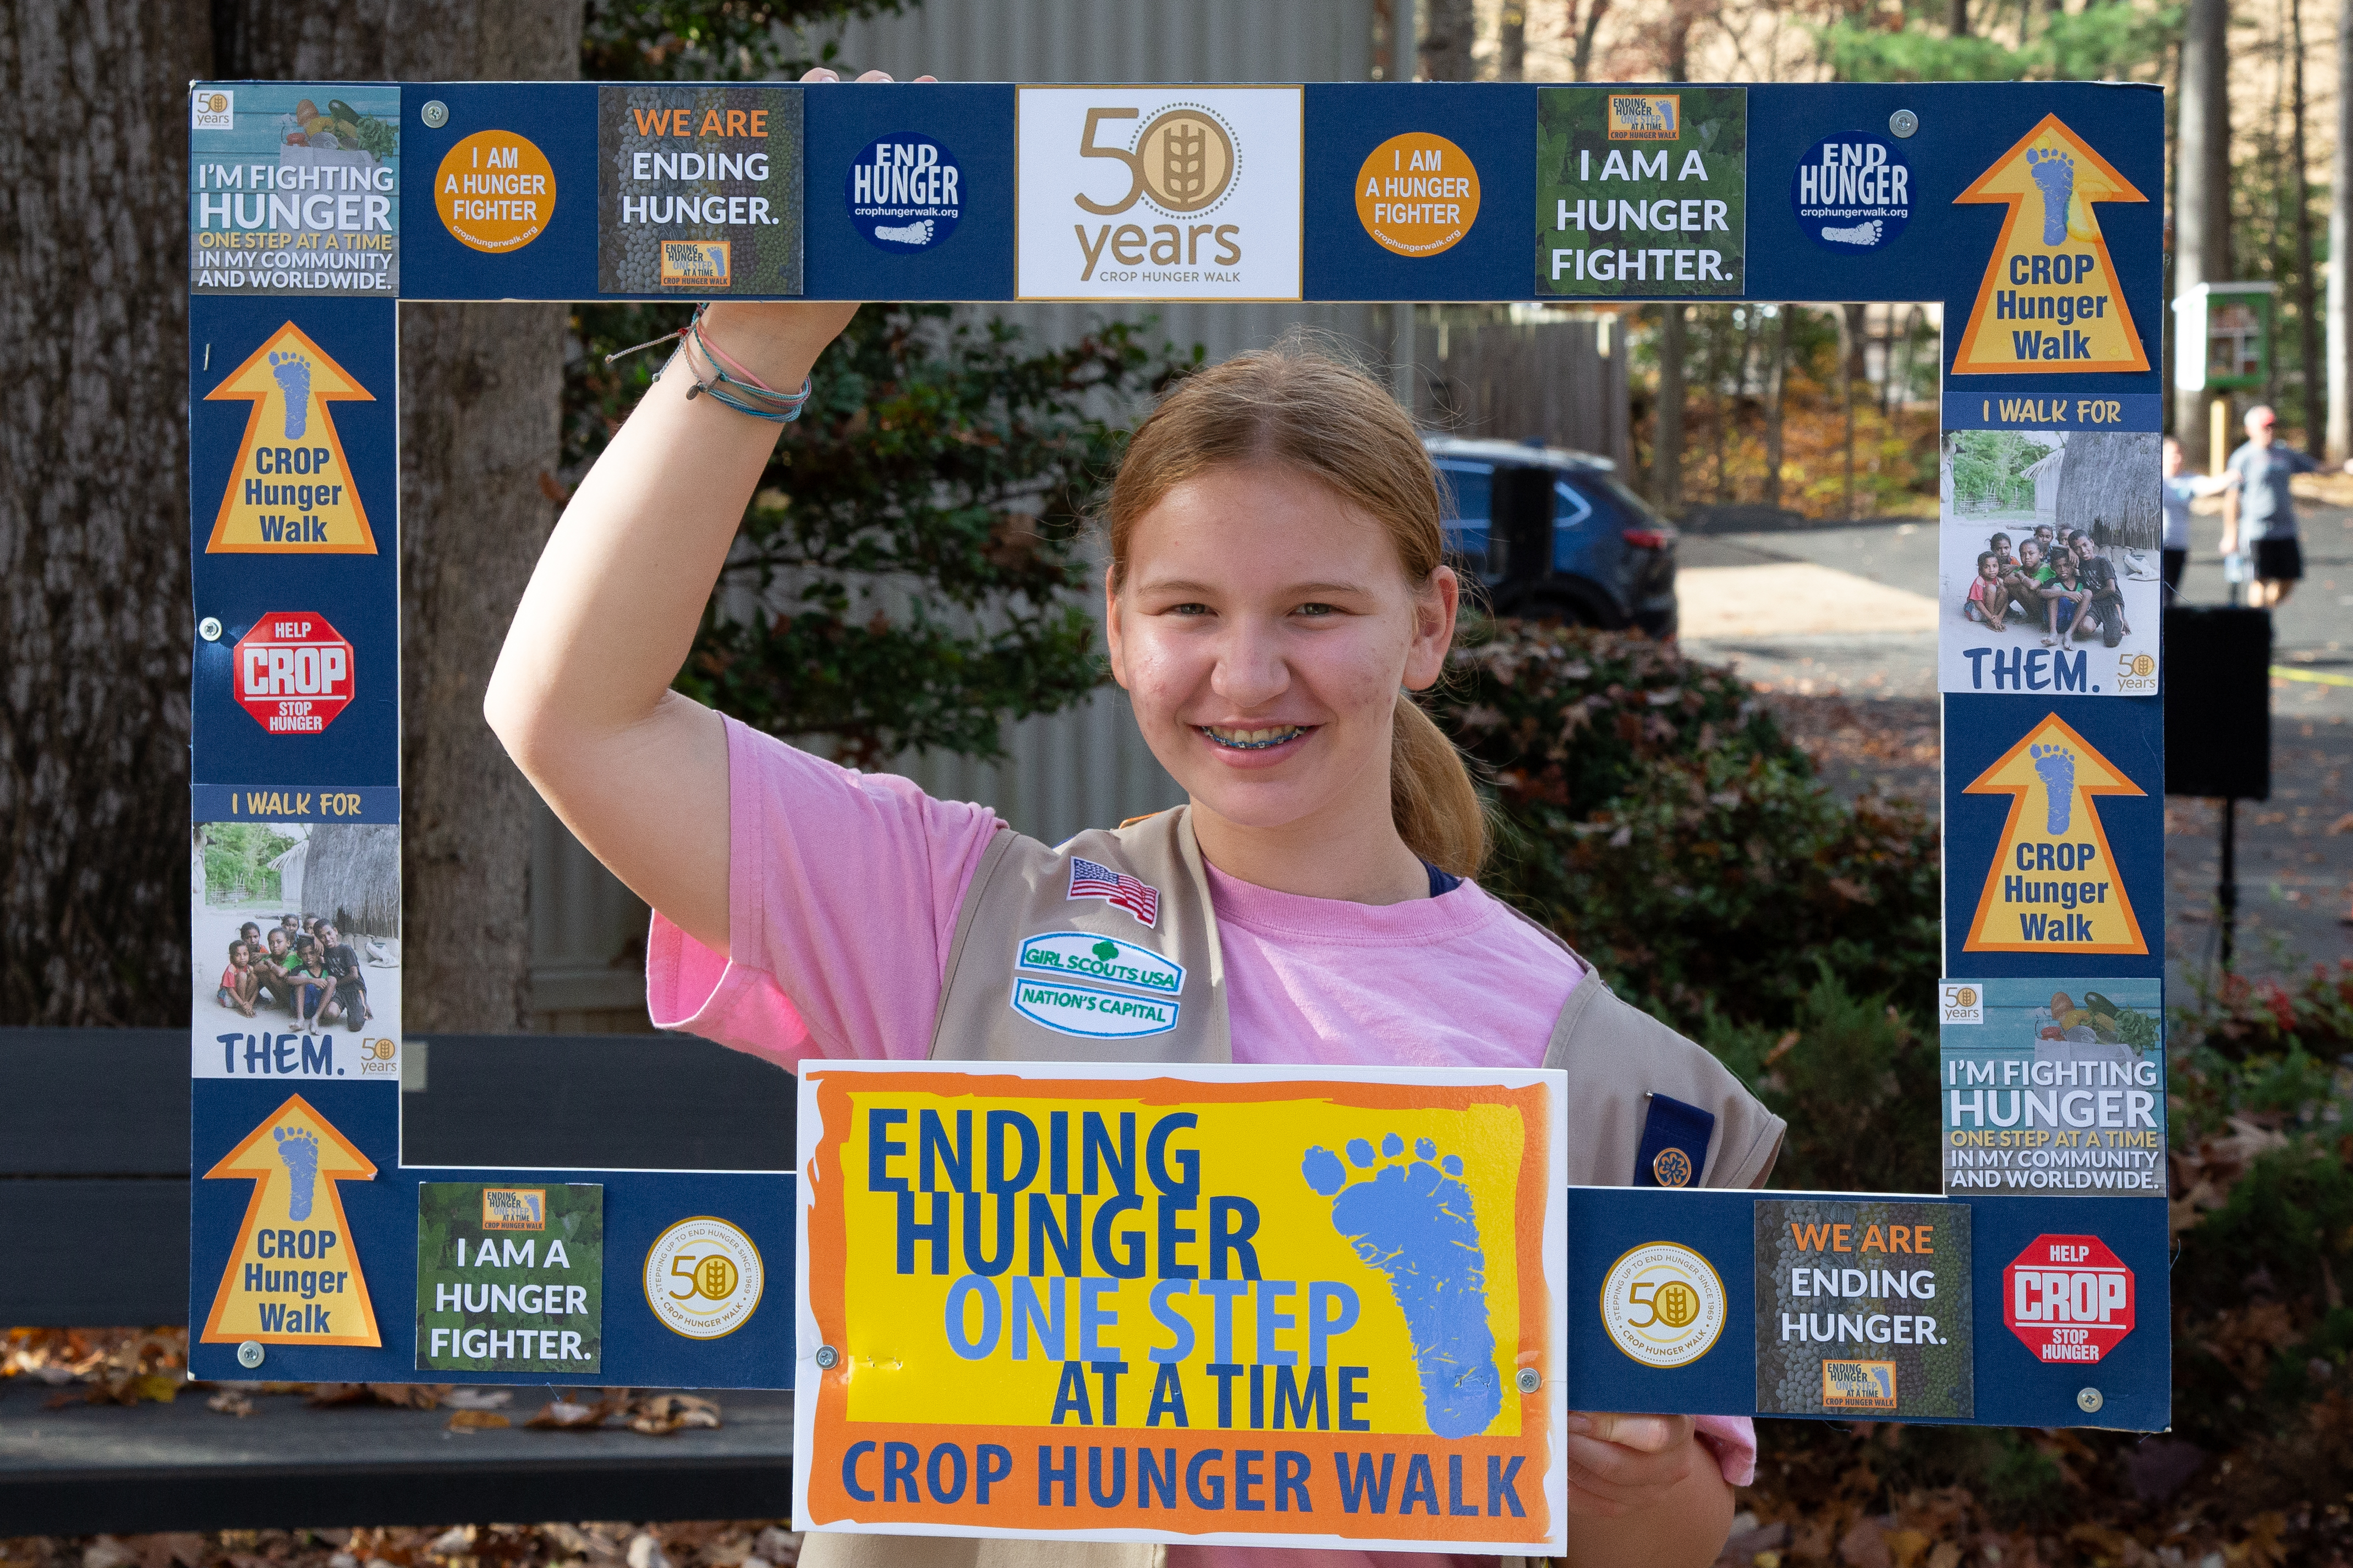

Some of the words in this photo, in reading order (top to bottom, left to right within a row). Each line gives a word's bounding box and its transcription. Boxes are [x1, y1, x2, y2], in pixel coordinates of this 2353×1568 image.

[198, 93, 227, 113] 50
[198, 115, 229, 125] years
[634, 109, 690, 136] WE
[699, 110, 769, 137] ARE
[473, 148, 478, 167] I
[487, 148, 518, 168] AM
[633, 153, 769, 181] ENDING
[876, 144, 937, 166] END
[1074, 108, 1234, 215] 50
[1395, 150, 1399, 170] I
[1409, 150, 1441, 171] AM
[1581, 150, 1589, 181] I
[1600, 150, 1668, 181] AM
[1678, 150, 1708, 181] A
[1823, 144, 1886, 167] END
[199, 164, 243, 188] I'M
[251, 165, 393, 191] FIGHTING
[445, 175, 458, 194] A
[463, 175, 545, 194] HUNGER
[855, 166, 958, 205] HUNGER
[1365, 178, 1380, 197] A
[1385, 177, 1469, 197] HUNGER
[1801, 166, 1908, 205] HUNGER
[199, 193, 392, 231] HUNGER
[454, 200, 536, 220] FIGHTER
[623, 196, 779, 224] HUNGER.
[855, 207, 958, 218] crophungerwalk.org
[1375, 203, 1460, 224] FIGHTER
[1557, 199, 1729, 231] HUNGER
[1801, 208, 1908, 218] crophungerwalk.org
[199, 232, 243, 247] ONE
[245, 233, 292, 248] STEP
[297, 234, 321, 248] AT
[325, 234, 340, 249] A
[342, 234, 392, 250] TIME
[453, 225, 537, 248] crophungerwalk.org
[1374, 229, 1461, 252] crophungerwalk.org
[199, 252, 221, 267] IN
[225, 252, 254, 267] MY
[261, 252, 392, 269] COMMUNITY
[1074, 224, 1241, 281] years
[1552, 249, 1732, 280] FIGHTER.
[198, 271, 245, 287] AND
[250, 272, 391, 289] WORLDWIDE.
[1100, 272, 1137, 282] CROP
[1143, 272, 1199, 282] HUNGER
[1204, 272, 1241, 282] WALK
[2009, 254, 2094, 285] CROP
[1997, 290, 2108, 326] Hunger
[2013, 331, 2091, 360] Walk
[1983, 400, 1989, 421] I
[2000, 398, 2067, 422] WALK
[2077, 400, 2121, 423] FOR
[256, 447, 330, 475] CROP
[245, 479, 342, 511] Hunger
[259, 515, 327, 542] Walk
[276, 623, 311, 637] HELP
[244, 648, 346, 695] CROP
[1963, 647, 2100, 693] THEM.
[2118, 654, 2154, 678] 50
[2118, 679, 2155, 692] years
[279, 702, 311, 716] STOP
[270, 717, 322, 731] HUNGER
[232, 793, 237, 813] I
[247, 792, 310, 815] WALK
[320, 794, 361, 816] FOR
[2016, 843, 2096, 871] CROP
[2005, 875, 2108, 910] Hunger
[2020, 914, 2093, 941] Walk
[1025, 949, 1063, 967] GIRL
[1067, 955, 1139, 981] SCOUTS
[1141, 971, 1175, 988] USA
[1023, 988, 1095, 1011] NATION'S
[1099, 999, 1166, 1022] CAPITAL
[1945, 987, 1977, 1008] 50
[1945, 1009, 1979, 1021] years
[217, 1032, 344, 1075] THEM.
[361, 1038, 395, 1060] 50
[361, 1063, 397, 1075] years
[1949, 1060, 1995, 1086] I'M
[2004, 1061, 2157, 1086] FIGHTING
[1951, 1090, 2157, 1128] HUNGER
[869, 1109, 1200, 1196] ENDING
[1950, 1130, 1995, 1146] ONE
[2000, 1130, 2049, 1147] STEP
[2055, 1131, 2080, 1147] AT
[2086, 1131, 2101, 1147] A
[2105, 1131, 2157, 1148] TIME
[1951, 1150, 1973, 1167] IN
[1979, 1151, 2014, 1167] MY
[2017, 1151, 2158, 1168] COMMUNITY
[1951, 1170, 2001, 1187] AND
[2005, 1171, 2159, 1189] WORLDWIDE.
[257, 1229, 336, 1259] CROP
[896, 1190, 1263, 1280] HUNGER
[1791, 1223, 1851, 1251] WE
[1861, 1225, 1933, 1253] ARE
[458, 1239, 465, 1267] I
[475, 1239, 534, 1268] AM
[544, 1240, 571, 1268] A
[656, 1252, 667, 1292] STEPPING
[666, 1242, 675, 1252] UP
[675, 1234, 686, 1242] TO
[708, 1229, 739, 1249] HUNGER
[738, 1249, 752, 1273] SINCE
[2050, 1245, 2089, 1262] HELP
[244, 1263, 348, 1300] Hunger
[669, 1255, 738, 1300] 50
[1613, 1280, 1624, 1321] STEPPING
[1623, 1268, 1631, 1279] UP
[1632, 1260, 1643, 1269] TO
[1666, 1255, 1699, 1275] HUNGER
[1698, 1274, 1713, 1299] SINCE
[1791, 1268, 1935, 1299] ENDING
[436, 1283, 588, 1314] HUNGER
[1628, 1281, 1700, 1328] 50
[2015, 1272, 2126, 1322] CROP
[259, 1303, 331, 1333] Walk
[663, 1302, 684, 1320] CROP
[684, 1318, 720, 1327] HUNGER
[722, 1302, 743, 1321] WALK
[944, 1274, 1119, 1362] ONE
[1148, 1279, 1361, 1367] STEP
[1623, 1330, 1644, 1349] CROP
[1646, 1345, 1684, 1355] HUNGER
[1685, 1329, 1706, 1349] WALK
[1782, 1313, 1947, 1345] HUNGER.
[2053, 1329, 2088, 1345] STOP
[430, 1329, 591, 1360] FIGHTER.
[2042, 1345, 2099, 1360] HUNGER
[1828, 1363, 1861, 1373] ENDING
[1831, 1372, 1867, 1382] HUNGER
[1050, 1361, 1128, 1426] AT
[1147, 1364, 1189, 1428] A
[1206, 1363, 1370, 1432] TIME
[1836, 1381, 1853, 1390] ONE
[1856, 1382, 1877, 1390] STEP
[842, 1440, 1013, 1505] CROP
[1037, 1445, 1313, 1513] HUNGER
[1334, 1452, 1527, 1519] WALK
